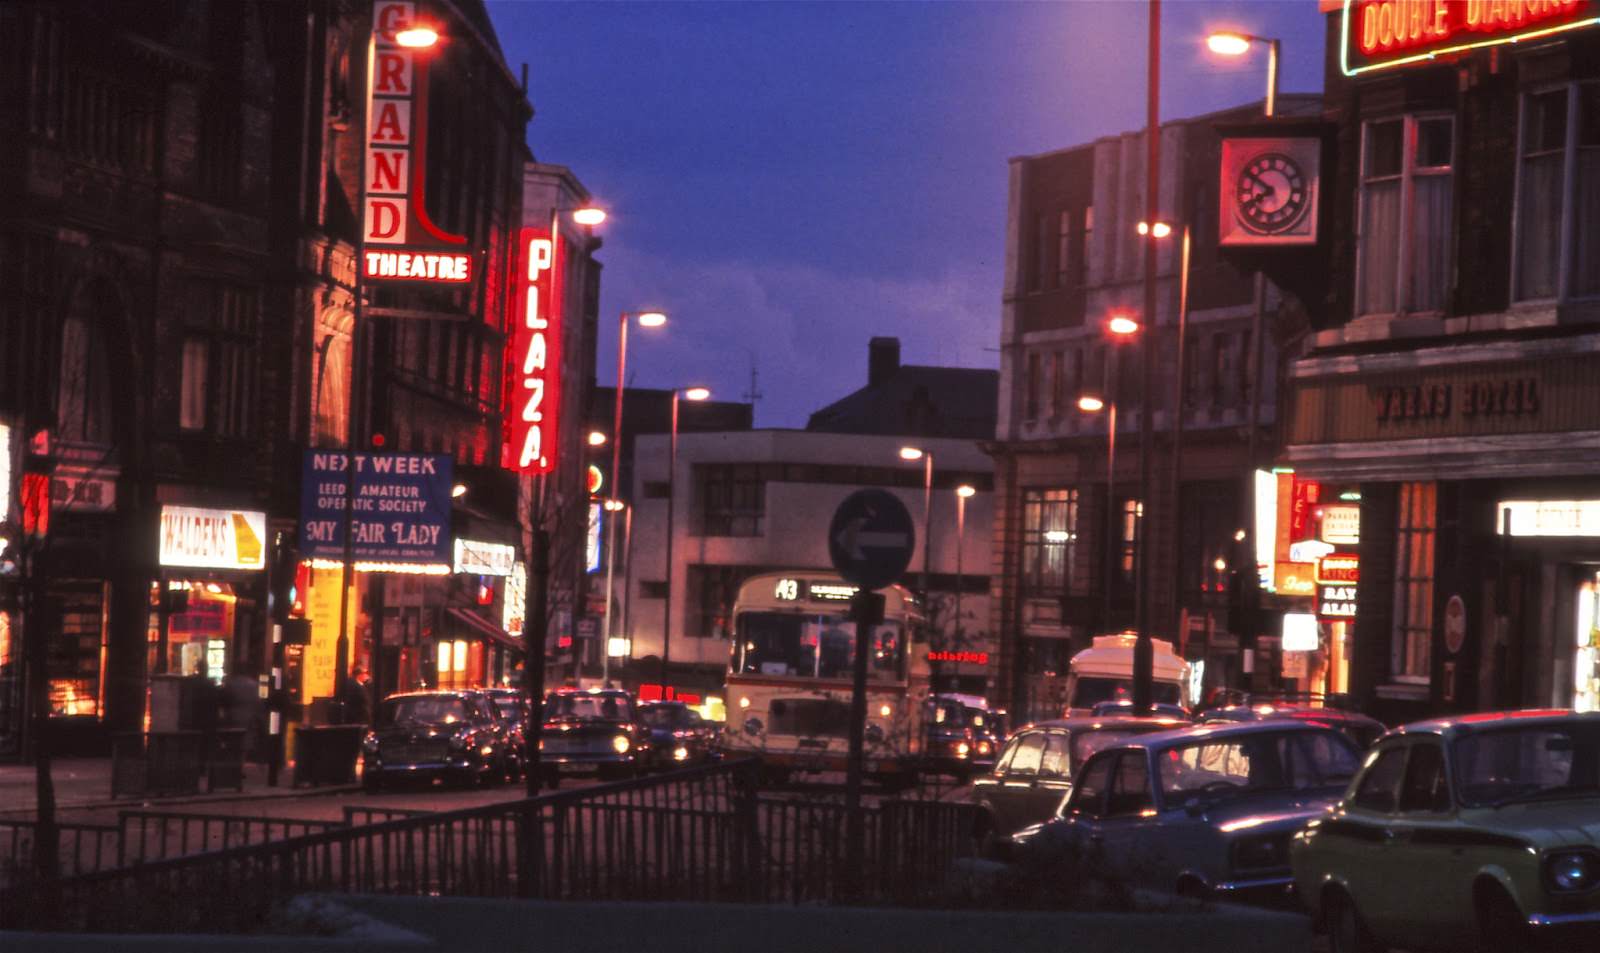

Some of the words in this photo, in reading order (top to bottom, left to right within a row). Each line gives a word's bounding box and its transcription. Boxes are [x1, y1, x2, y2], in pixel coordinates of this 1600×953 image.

[1362, 0, 1449, 49] DOUBLE
[370, 4, 408, 239] GRAND
[366, 253, 468, 280] THEATRE
[373, 456, 436, 475] WEEK
[319, 482, 346, 494] LEED
[360, 484, 420, 497] AMATEUR
[378, 499, 427, 513] SOCIETY
[161, 513, 227, 557] WALDENS
[306, 520, 337, 541] MY
[392, 521, 441, 546] LADY
